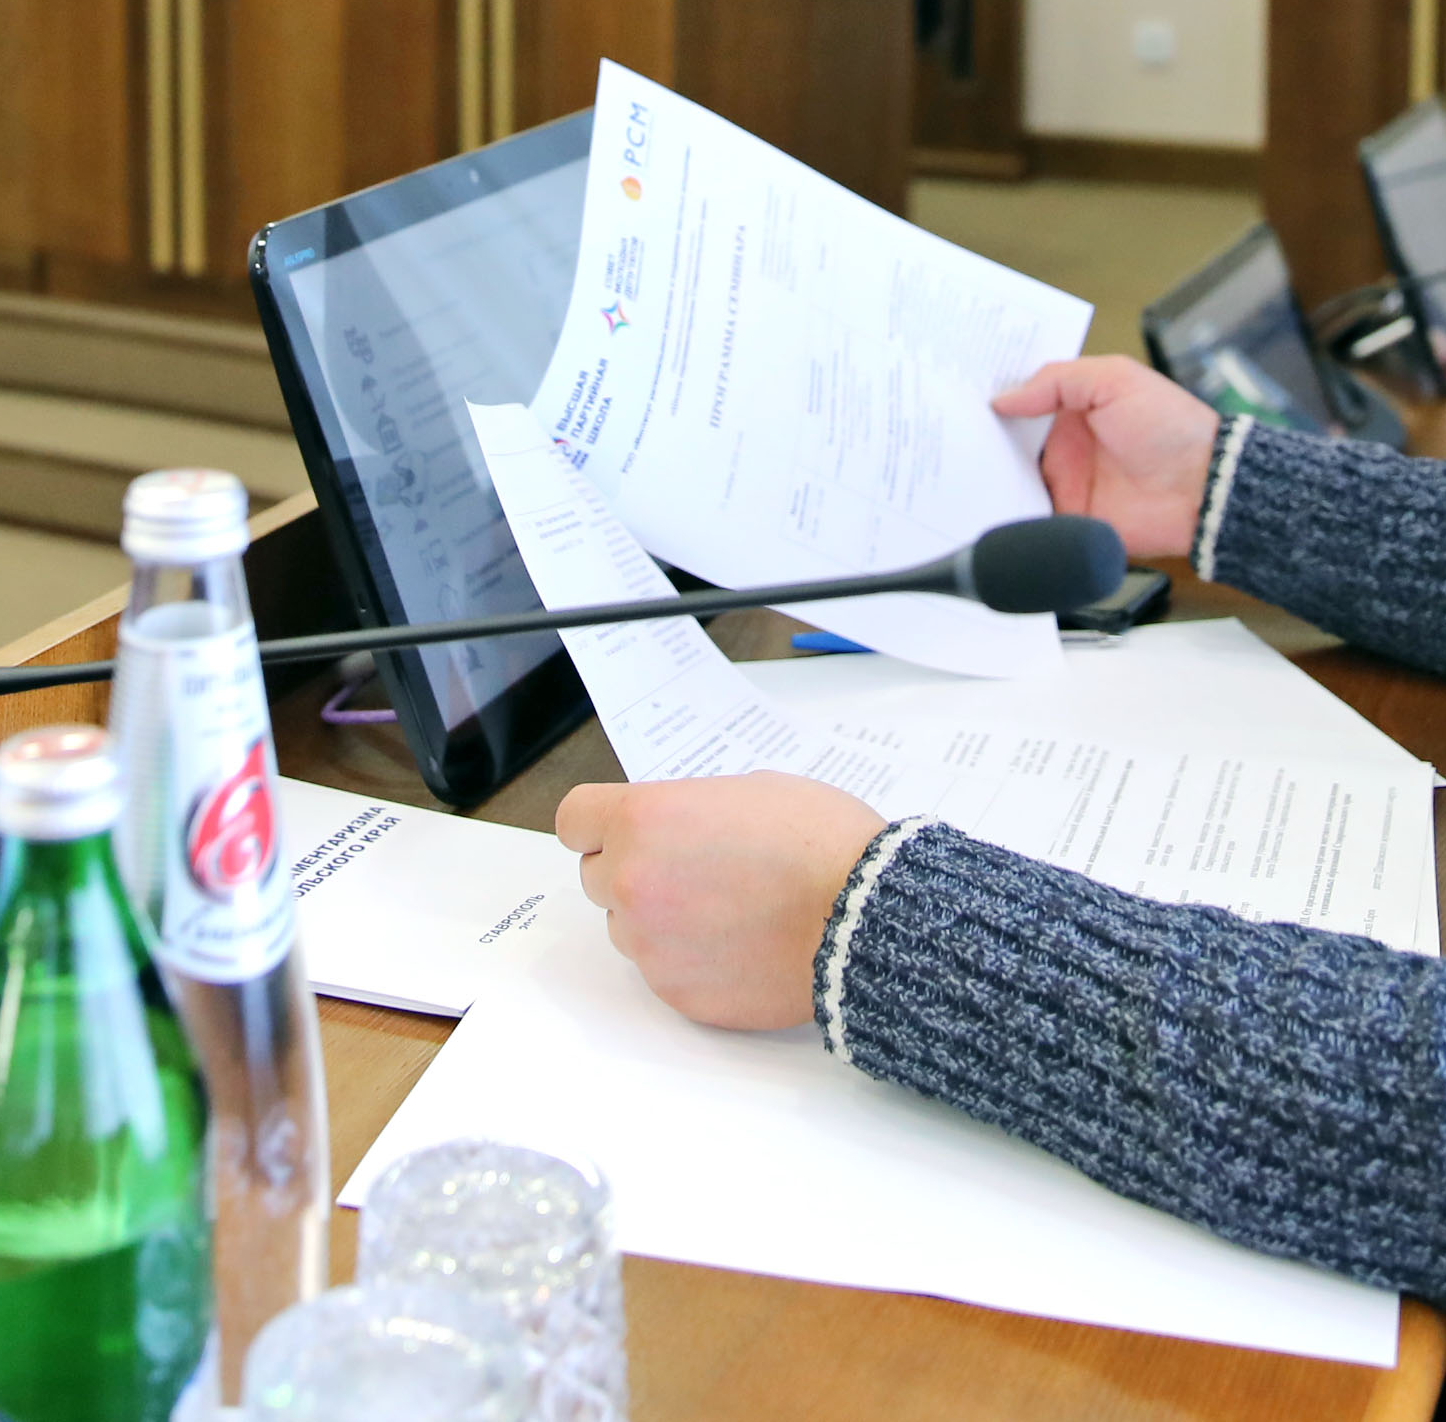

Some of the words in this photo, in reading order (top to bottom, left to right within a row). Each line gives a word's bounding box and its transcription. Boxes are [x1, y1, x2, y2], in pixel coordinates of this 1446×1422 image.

[623, 100, 649, 167] РСМ
[709, 320, 736, 429] ПРОГРАММА
[729, 225, 746, 315] СЕМИНАРА
[556, 370, 589, 432] ВЫСШАЯ
[570, 358, 609, 439] ПАРТИЙНАЯ
[585, 396, 613, 445] ШКОЛА
[293, 844, 365, 901] ОЛЬСКОГО
[359, 816, 402, 843] КРАЯ
[479, 894, 545, 943] СТАВРОПОЛЬ
